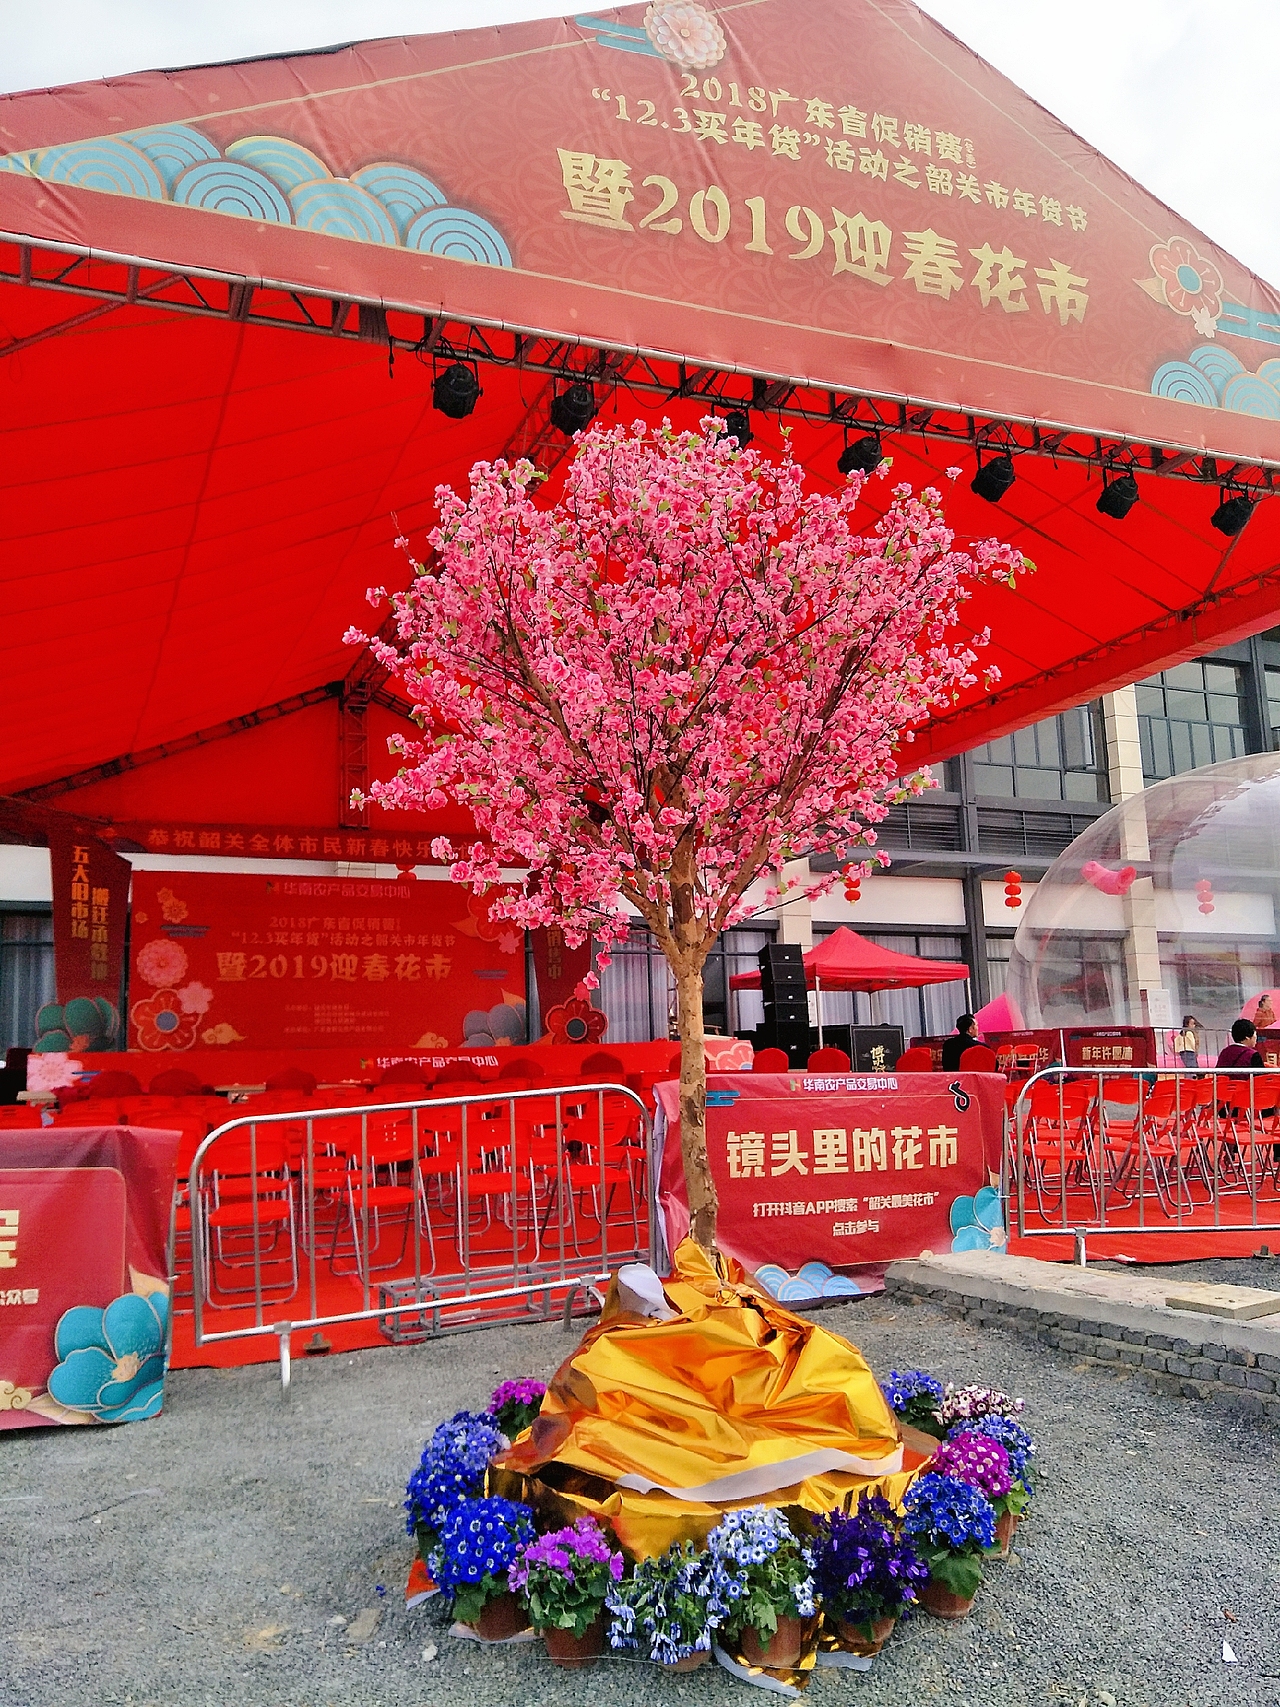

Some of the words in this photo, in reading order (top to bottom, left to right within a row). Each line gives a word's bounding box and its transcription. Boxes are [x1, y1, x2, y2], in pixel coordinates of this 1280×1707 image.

[681, 73, 962, 164] 2018广东省促销费
[557, 147, 1089, 326] 暨2019迎春花市
[284, 881, 411, 899] 华南农产品交易中心
[216, 951, 452, 982] 暨2019迎春花市
[803, 1077, 898, 1092] 华南农产品交易中心
[726, 1124, 958, 1178] 镜头里的花市
[832, 1220, 880, 1237] 点击参与
